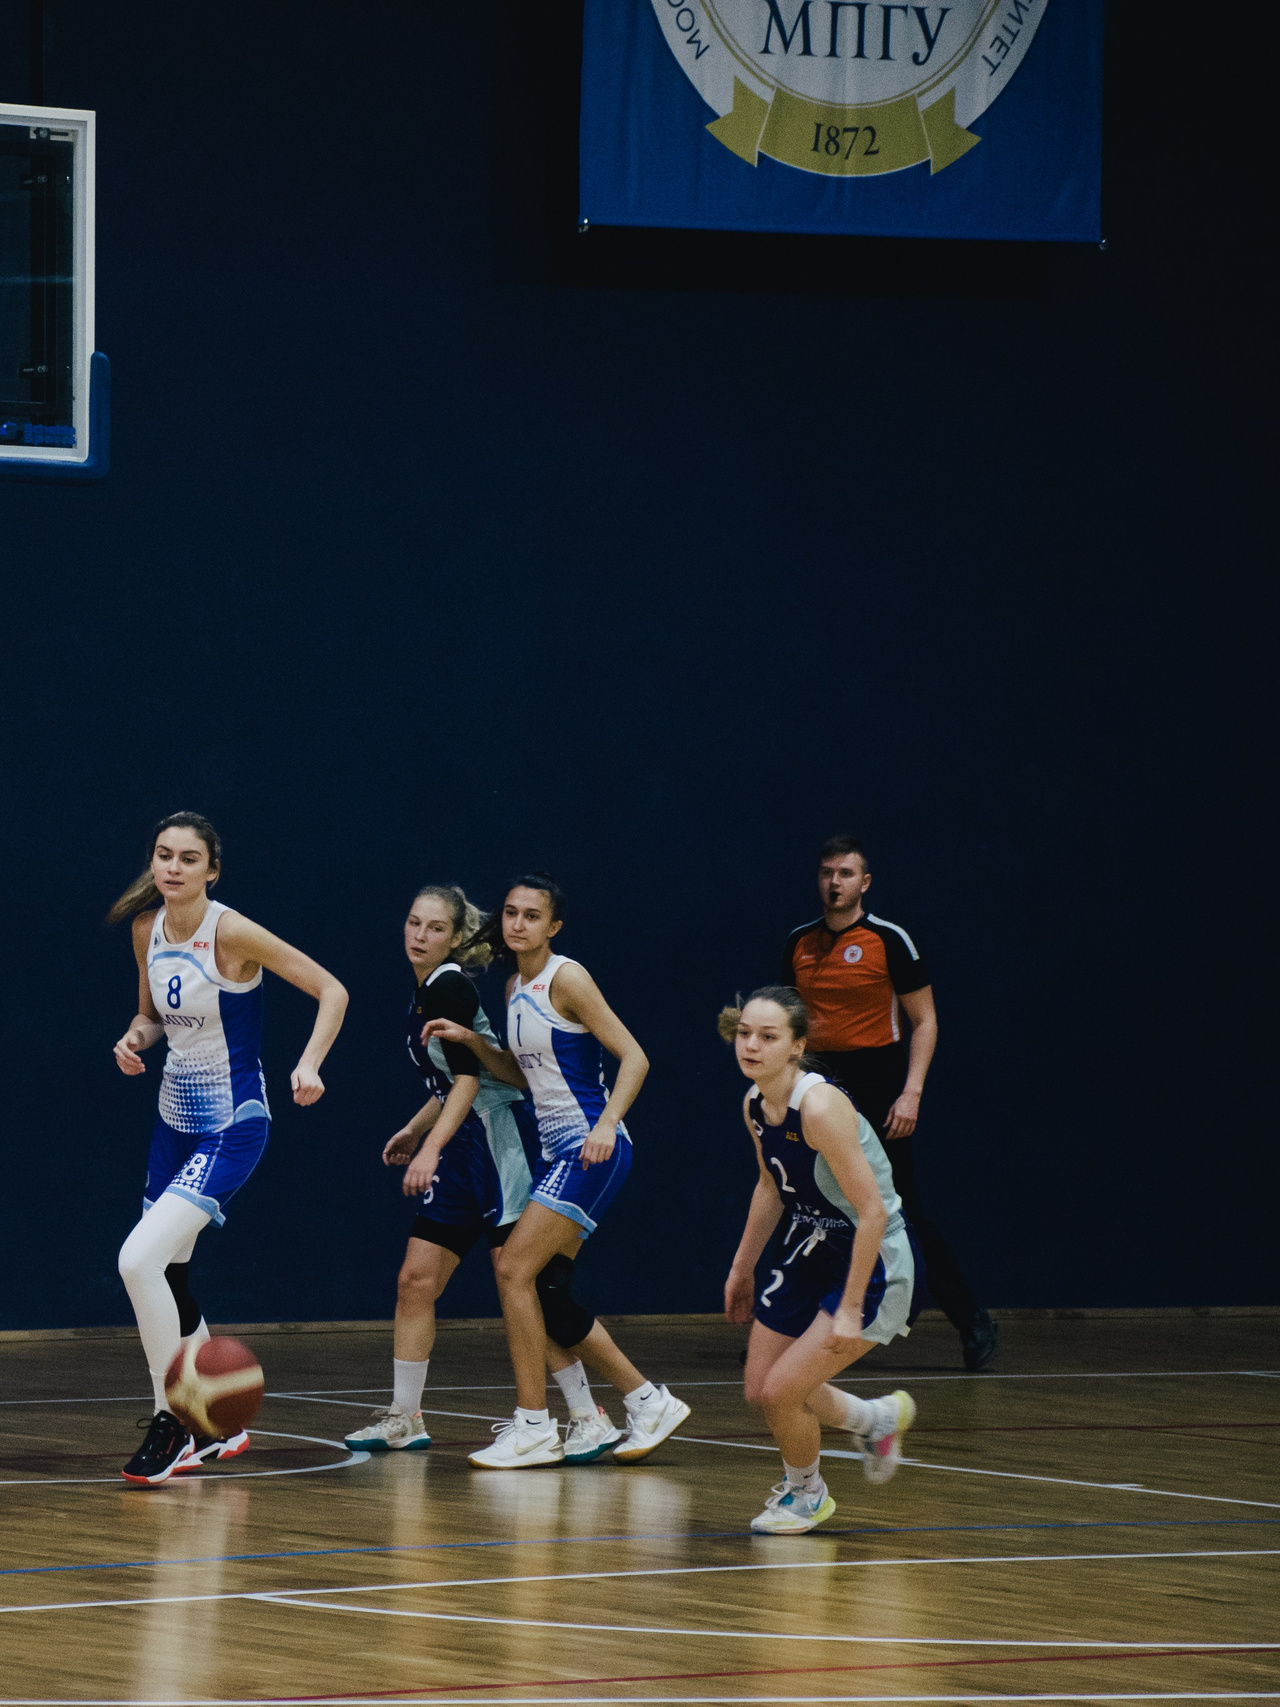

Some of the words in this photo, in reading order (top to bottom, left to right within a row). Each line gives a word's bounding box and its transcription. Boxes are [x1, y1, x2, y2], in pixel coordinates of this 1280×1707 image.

[758, 0, 953, 66] МПГУ
[981, 0, 1034, 77] ИТЕТ
[811, 122, 880, 160] 1872
[167, 975, 182, 1010] 8
[182, 1153, 208, 1182] 8
[770, 1157, 797, 1193] 2
[761, 1269, 785, 1308] 2
